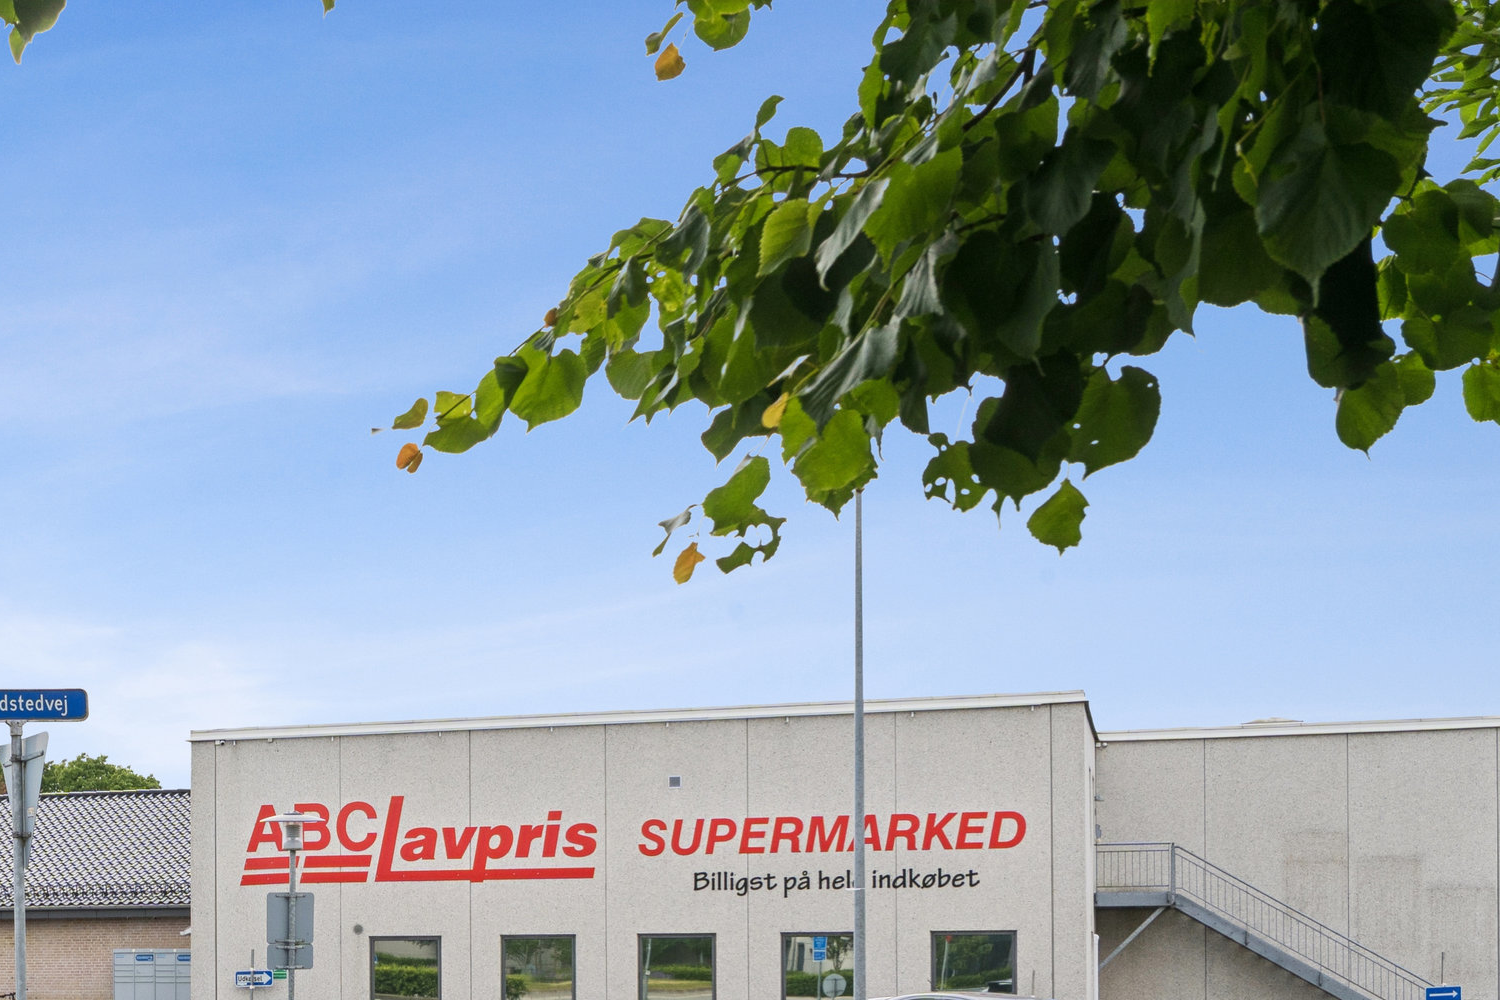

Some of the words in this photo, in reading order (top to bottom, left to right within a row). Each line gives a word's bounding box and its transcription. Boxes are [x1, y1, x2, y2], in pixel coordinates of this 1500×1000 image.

[246, 801, 378, 853] ABC
[374, 795, 598, 883] Lavpris
[638, 811, 1027, 857] SUPERMARKED
[693, 869, 778, 896] Billigst
[783, 870, 811, 898] på
[818, 869, 856, 890] hel
[872, 867, 981, 889] indkøbet
